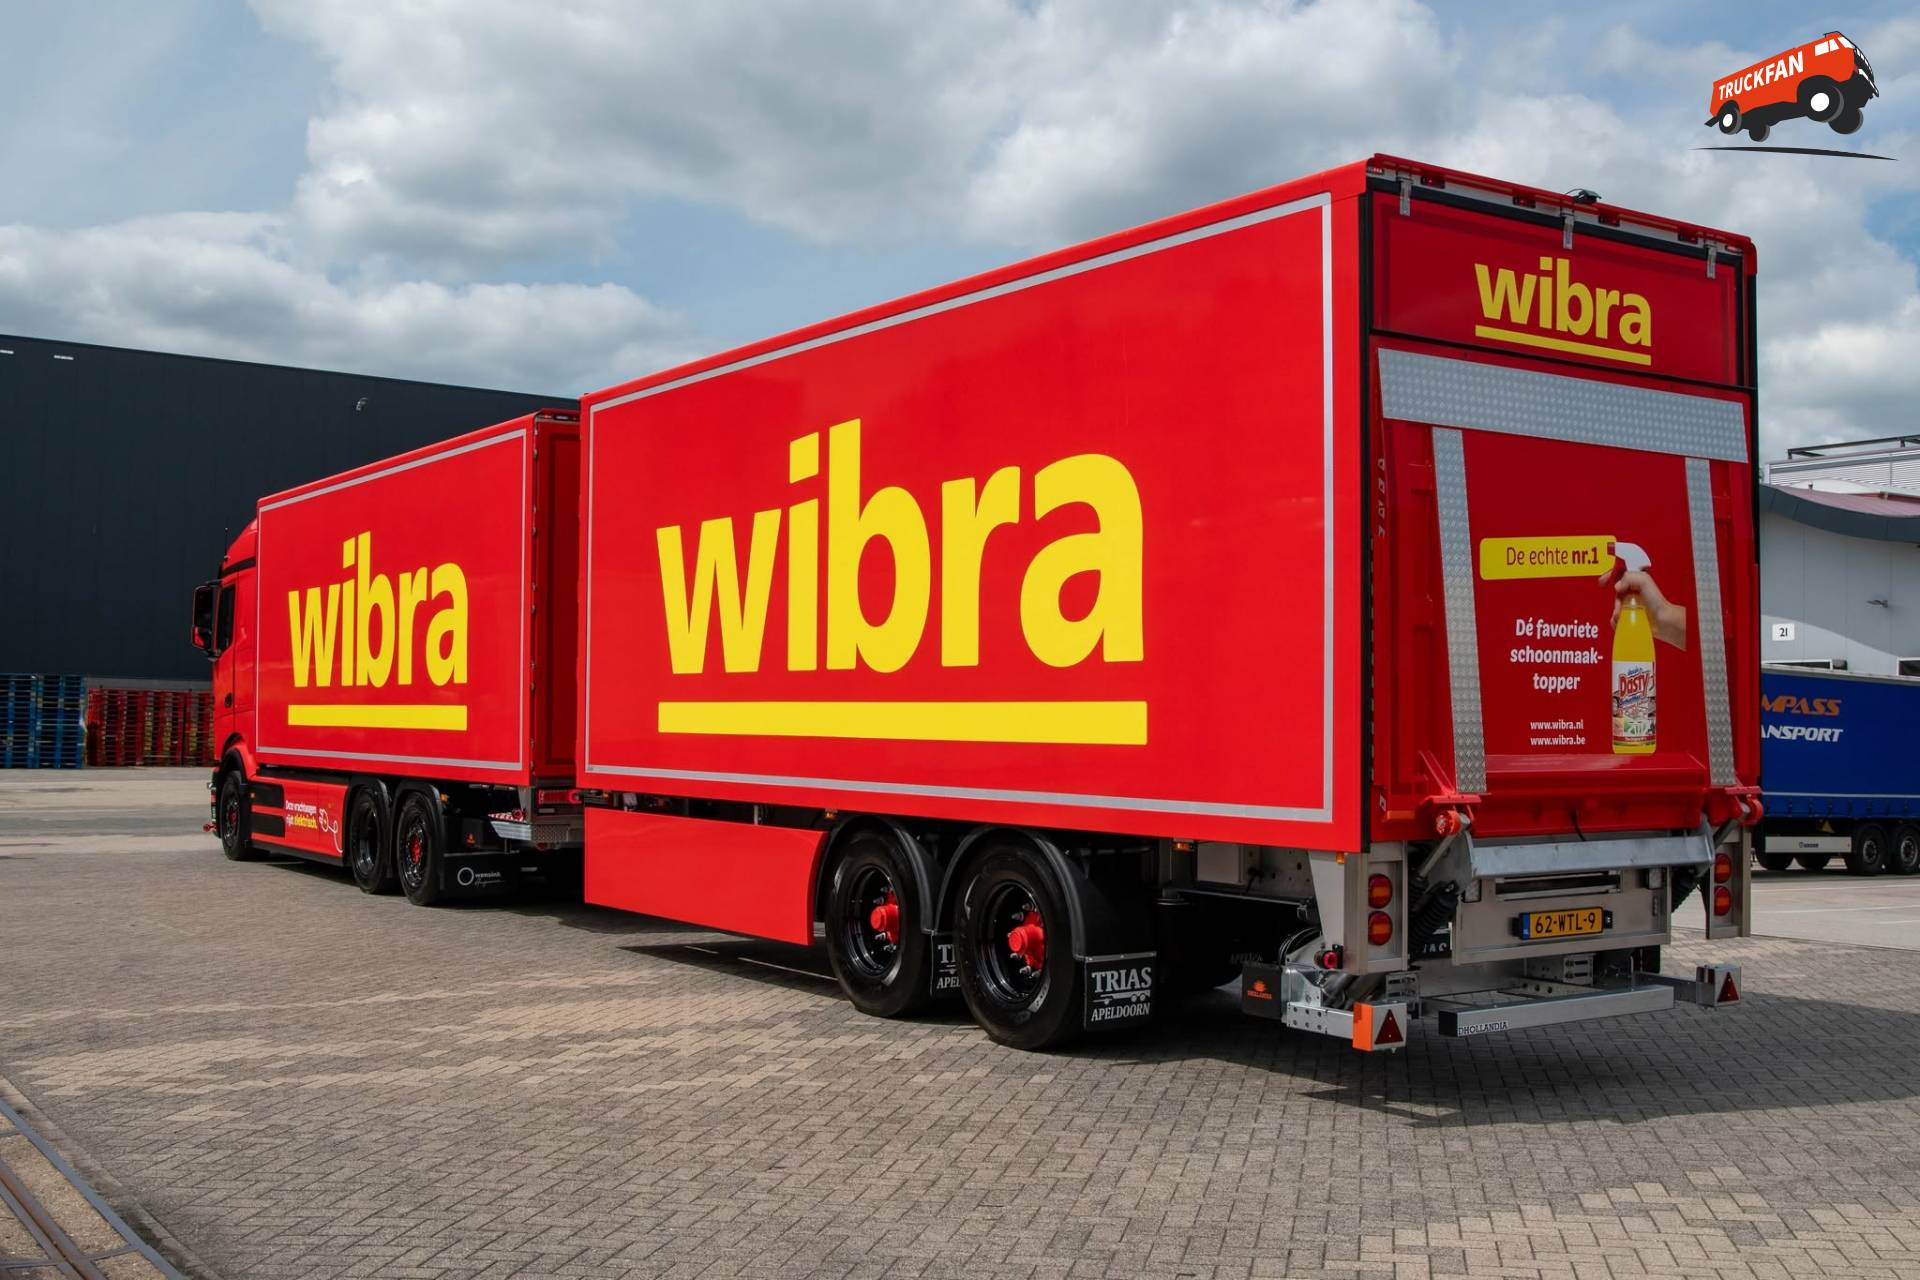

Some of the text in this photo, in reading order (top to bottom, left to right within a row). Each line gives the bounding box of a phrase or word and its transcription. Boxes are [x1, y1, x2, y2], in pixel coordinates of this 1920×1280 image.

[1475, 257, 1651, 346] wibra
[657, 419, 1143, 674] wibra
[1506, 546, 1599, 565] De echte nr.1
[289, 532, 468, 687] wibra
[1516, 617, 1598, 639] Dé favoriete
[1510, 645, 1603, 663] schoonmaak-
[1533, 673, 1580, 693] topper
[1530, 719, 1584, 730] www.wibra.nl
[1530, 735, 1585, 745] www.wibra.be
[1535, 912, 1596, 934] 62-WTL-9
[1091, 967, 1152, 993] TRIAS
[1091, 1002, 1151, 1022] APELDOORN
[1458, 1021, 1508, 1035] DHOLLANDIA
